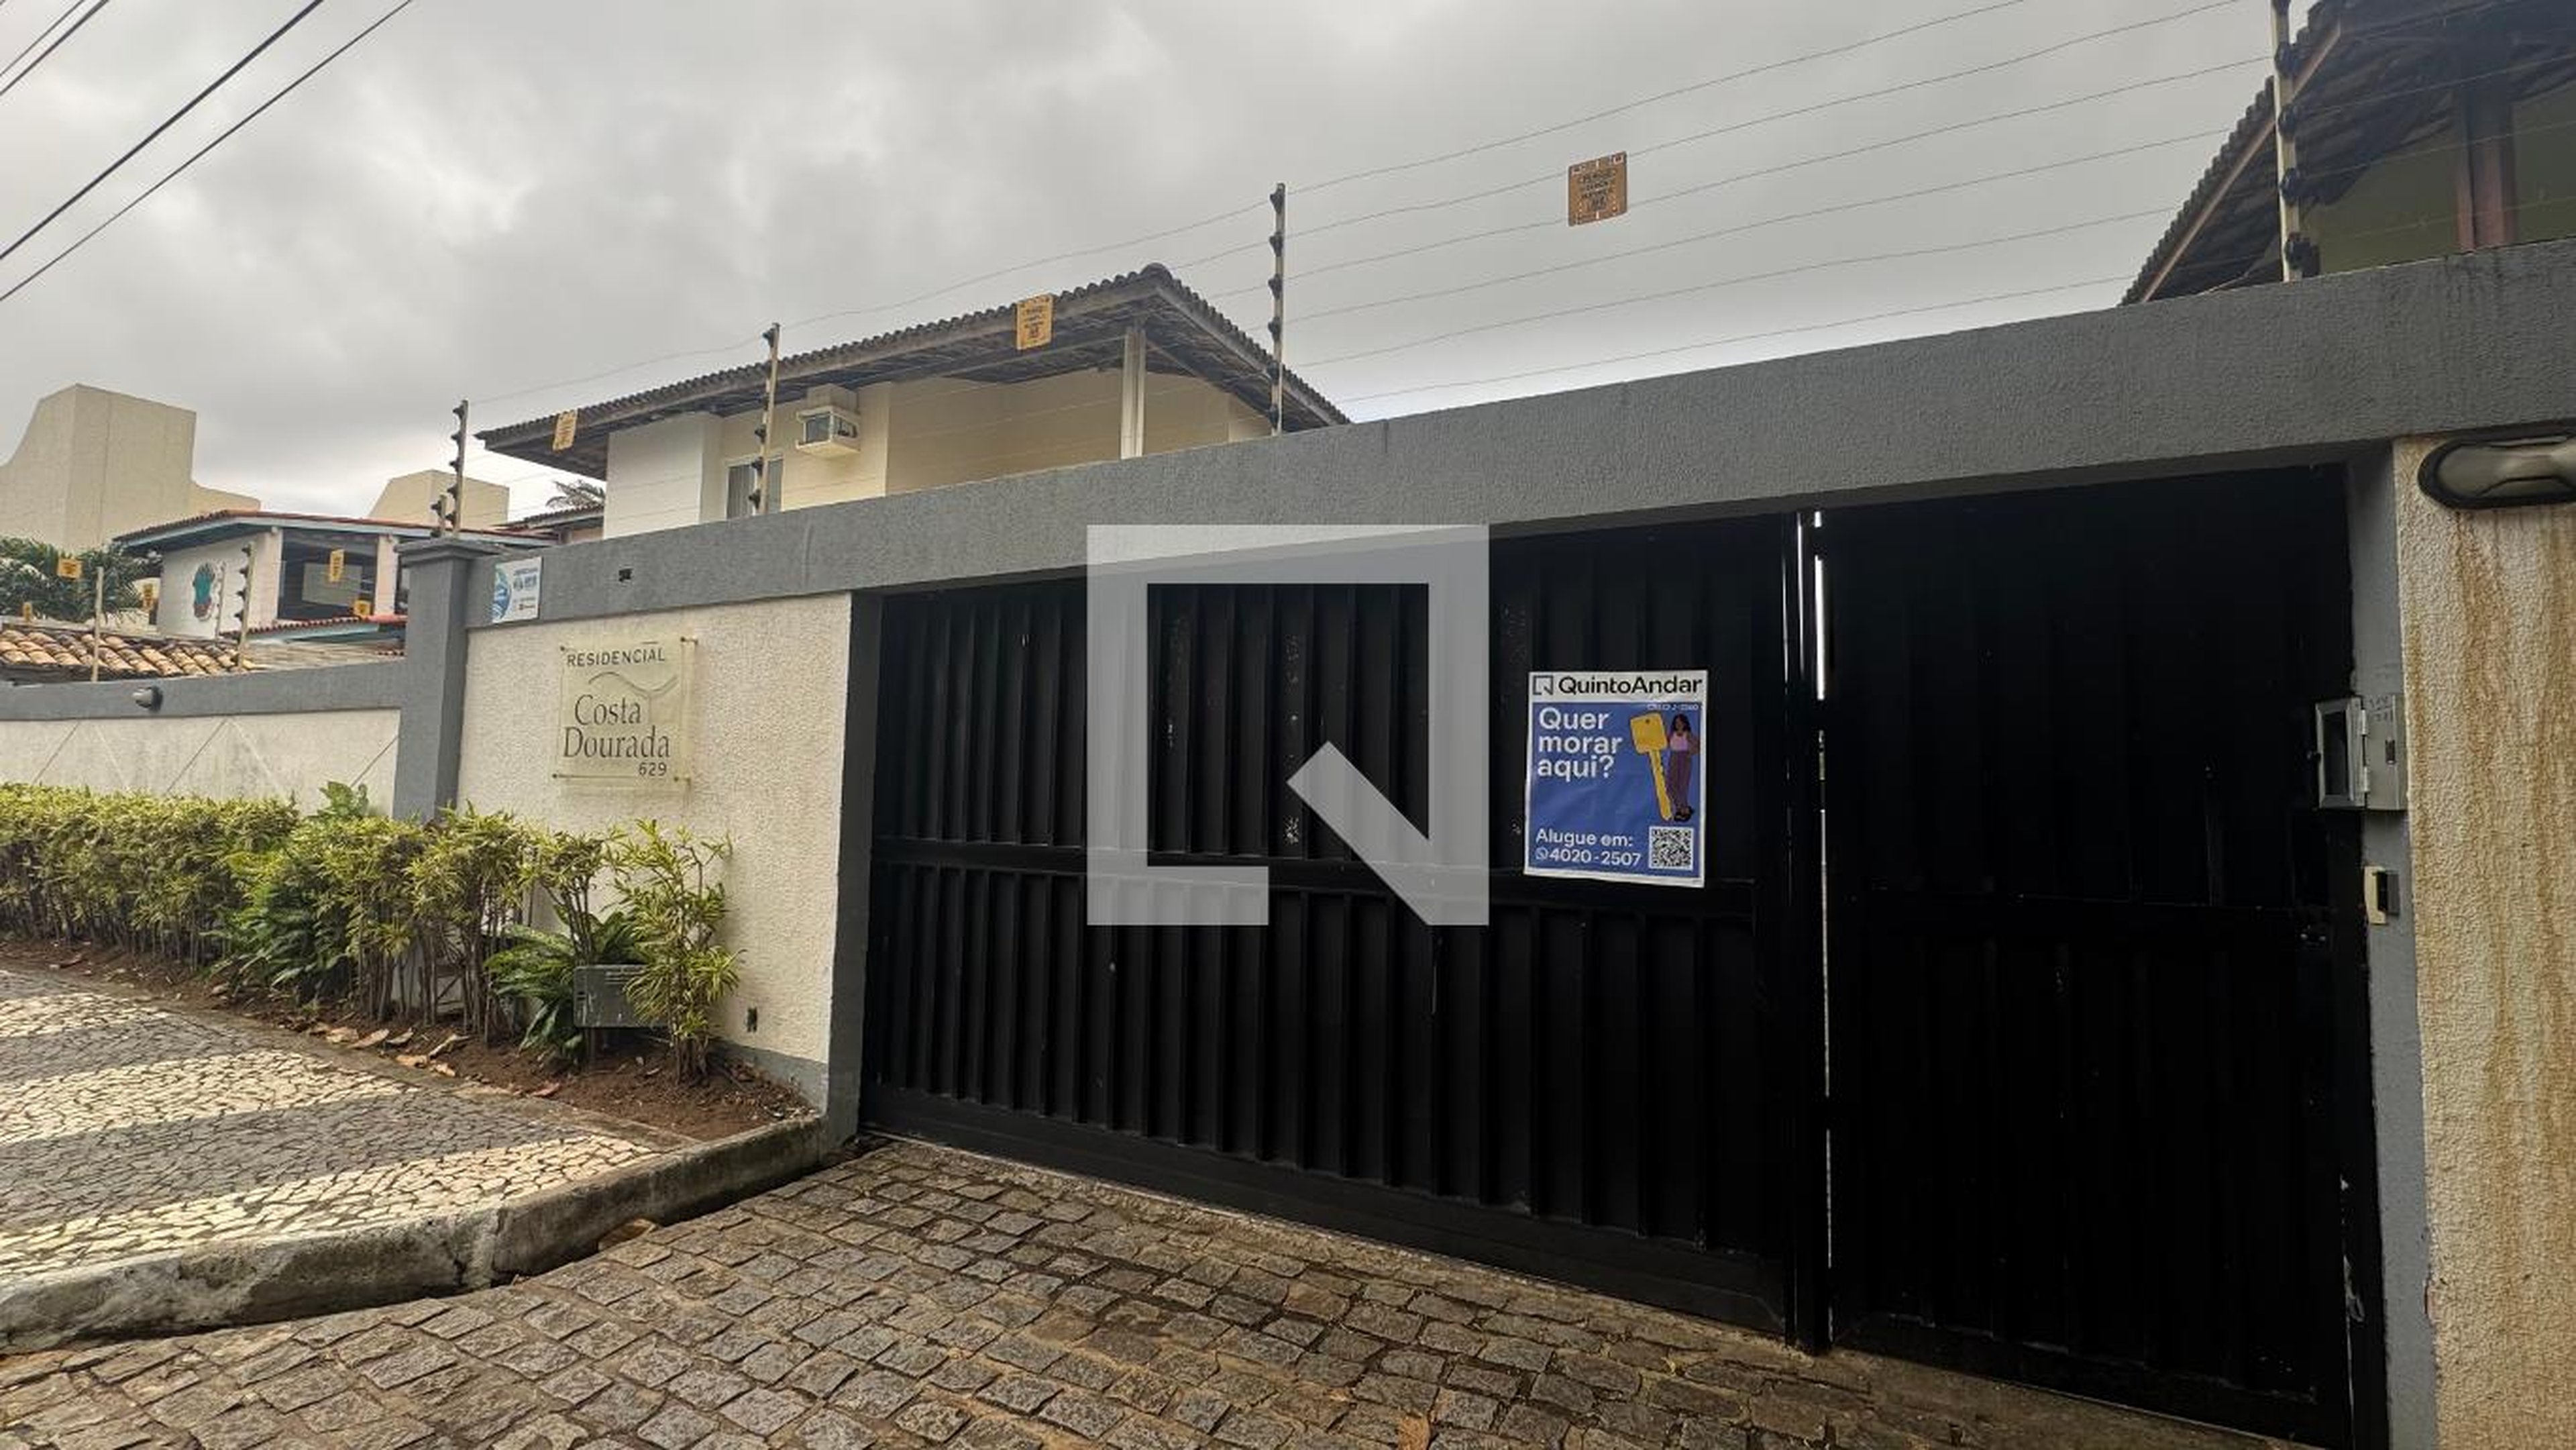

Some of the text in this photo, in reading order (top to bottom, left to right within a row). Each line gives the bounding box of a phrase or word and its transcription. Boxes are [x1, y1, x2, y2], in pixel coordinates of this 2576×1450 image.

[567, 648, 665, 666] RESIDENCIAL
[1558, 676, 1703, 694] QuintoAndar
[574, 694, 641, 725] Costa
[1539, 707, 1609, 730] Quer
[564, 725, 671, 758] Dourada
[1538, 736, 1622, 754] morar
[639, 762, 667, 777] 629
[1538, 756, 1614, 782] aqui?
[1536, 829, 1632, 847] Alugue em:
